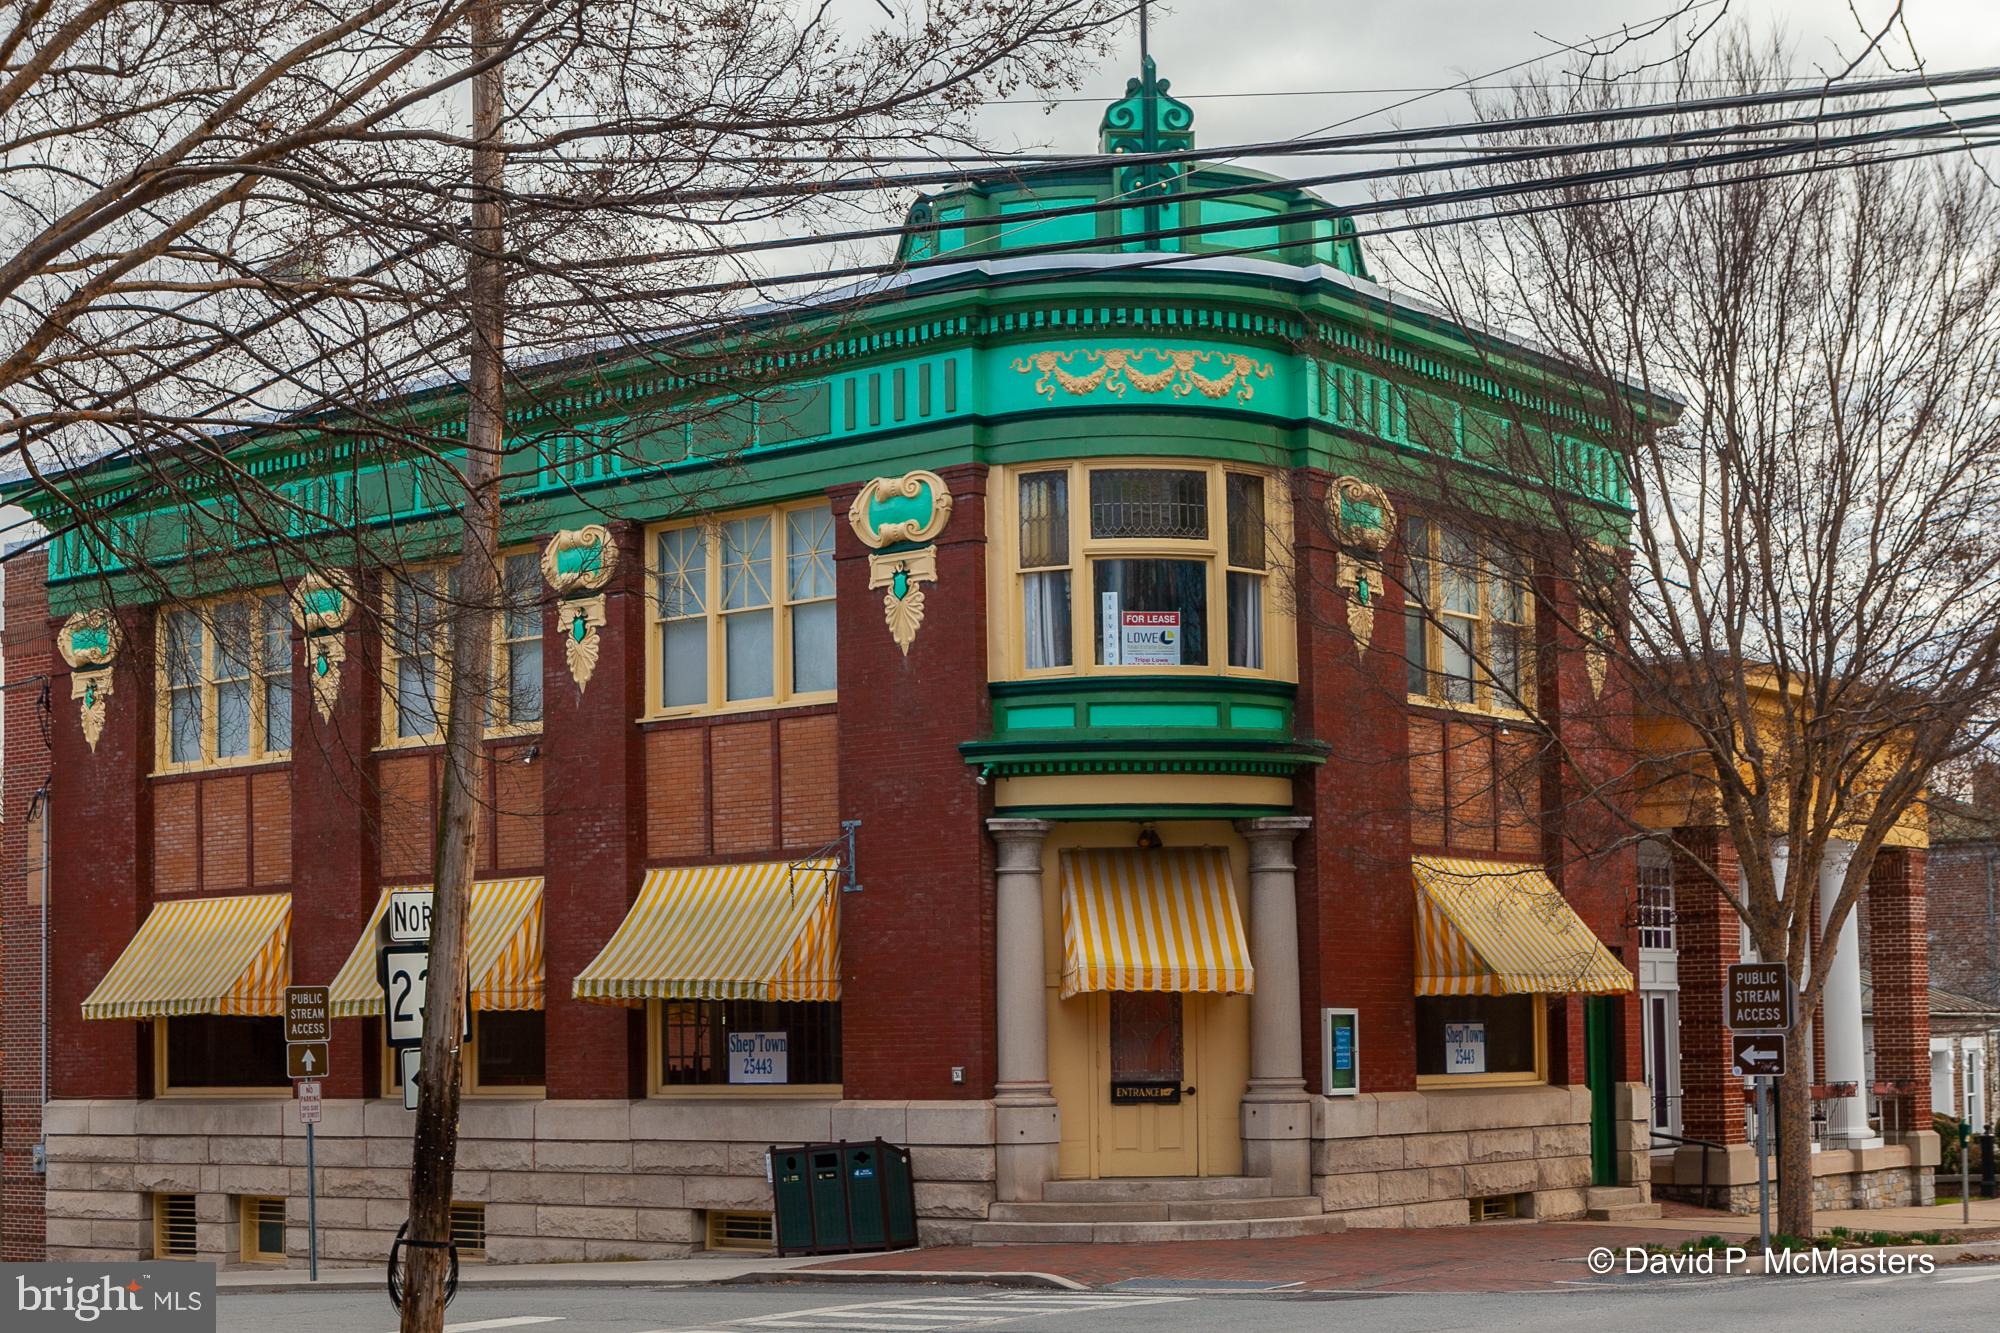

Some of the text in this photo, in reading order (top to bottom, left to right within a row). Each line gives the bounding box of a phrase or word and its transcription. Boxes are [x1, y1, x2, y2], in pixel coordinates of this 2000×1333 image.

[1126, 615, 1176, 623] FOR LEASE
[1127, 632, 1159, 644] LOWE
[1736, 971, 1777, 985] PUBLIC
[291, 993, 323, 1004] PUBLIC
[1735, 990, 1780, 1003] STREAM
[291, 1008, 325, 1019] STREAM
[1736, 1008, 1781, 1021] ACCESS
[291, 1023, 325, 1034] ACCESS
[1455, 1048, 1475, 1064] 25443
[743, 1058, 773, 1074] 25443
[1116, 1087, 1159, 1097] ENTRANCE
